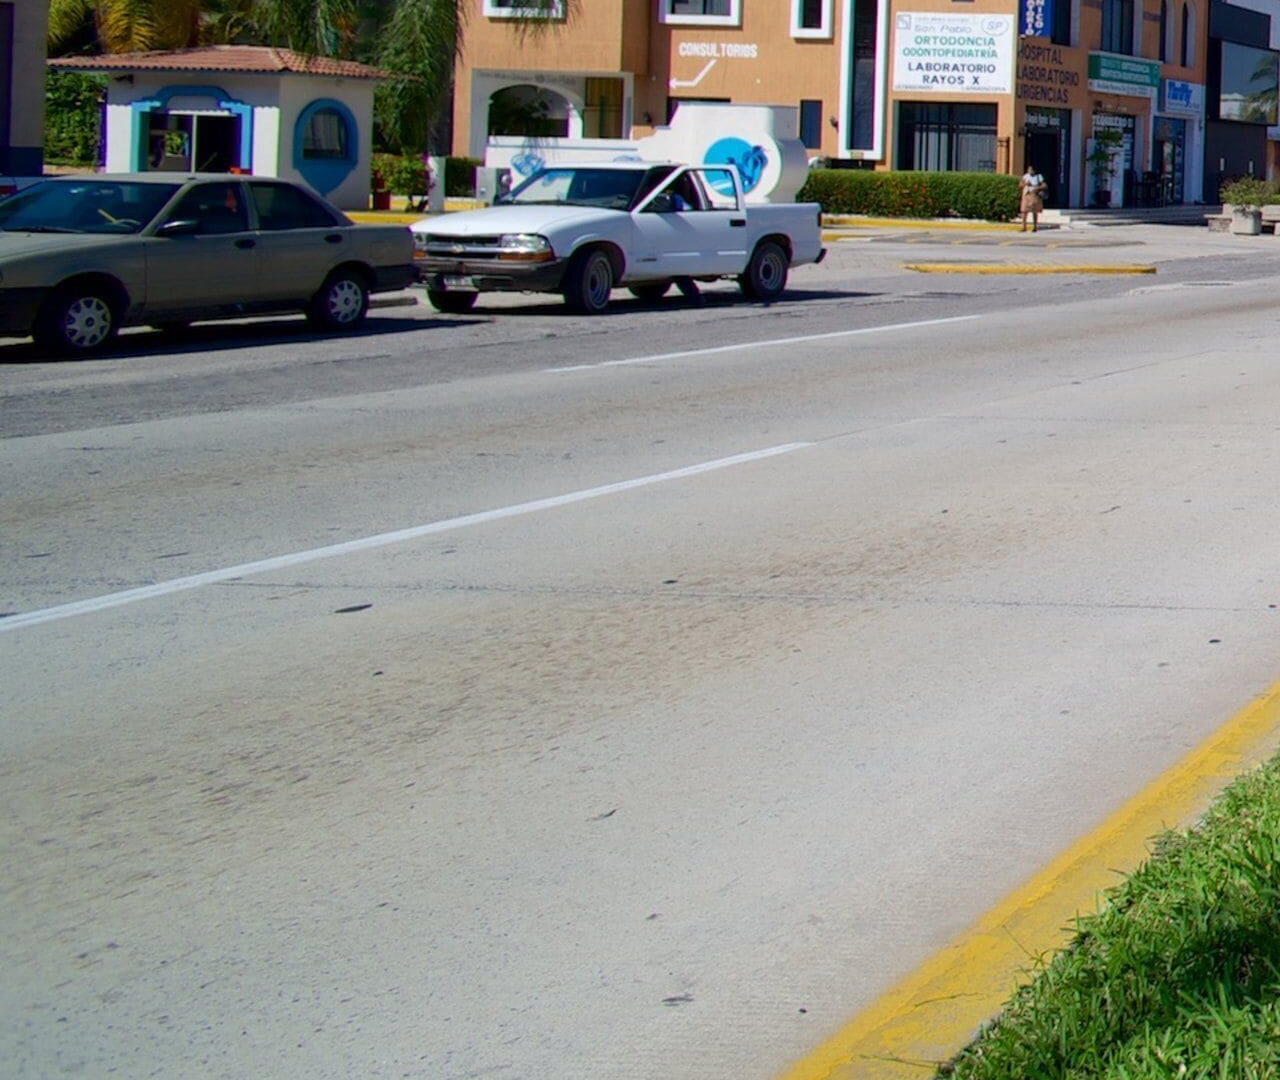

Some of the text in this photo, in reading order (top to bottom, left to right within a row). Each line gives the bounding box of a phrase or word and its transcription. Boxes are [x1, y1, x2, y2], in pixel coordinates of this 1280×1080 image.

[914, 35, 997, 47] ORTODONCIA
[678, 42, 758, 58] CONSULTORIOS
[908, 62, 997, 74] LABORATORIO
[922, 75, 980, 85] RAYOS X
[1017, 64, 1080, 87] LABORATORIO
